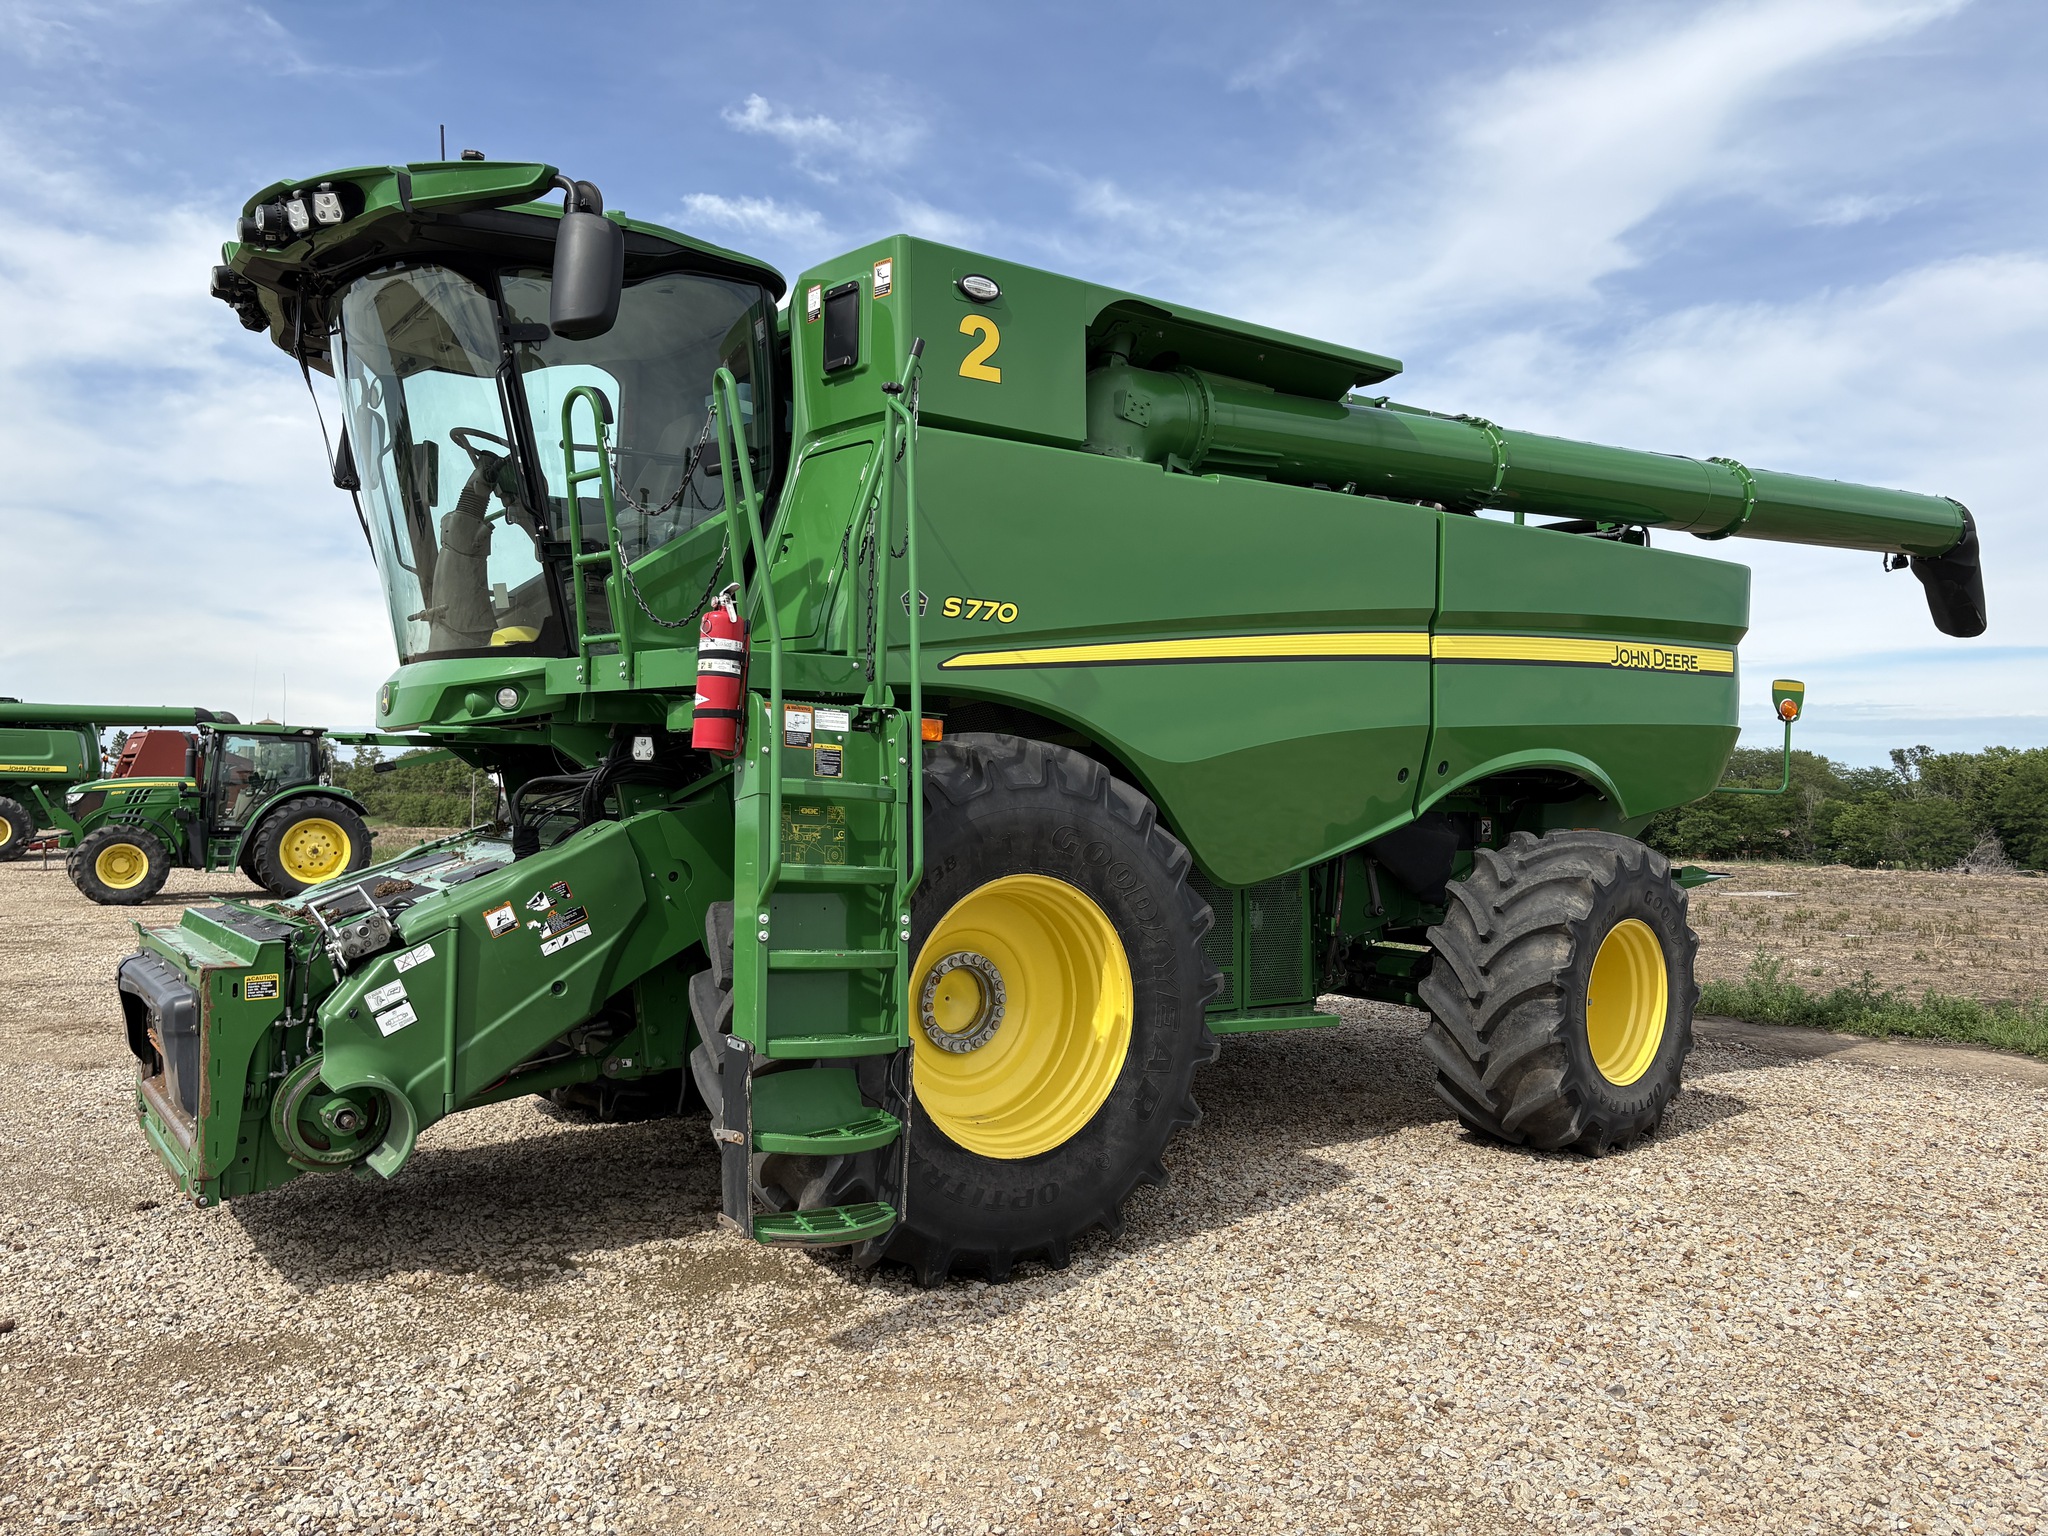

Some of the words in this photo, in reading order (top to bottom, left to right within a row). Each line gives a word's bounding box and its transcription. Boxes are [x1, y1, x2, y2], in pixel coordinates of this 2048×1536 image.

[958, 314, 1002, 384] 2
[942, 596, 1019, 624] S770
[1611, 645, 1650, 666] JOHN
[1653, 648, 1699, 670] DEERE
[1050, 824, 1181, 1123] GOODYEAR
[1588, 1080, 1662, 1116] OPTITRAC
[912, 1148, 1061, 1211] OPTITR
